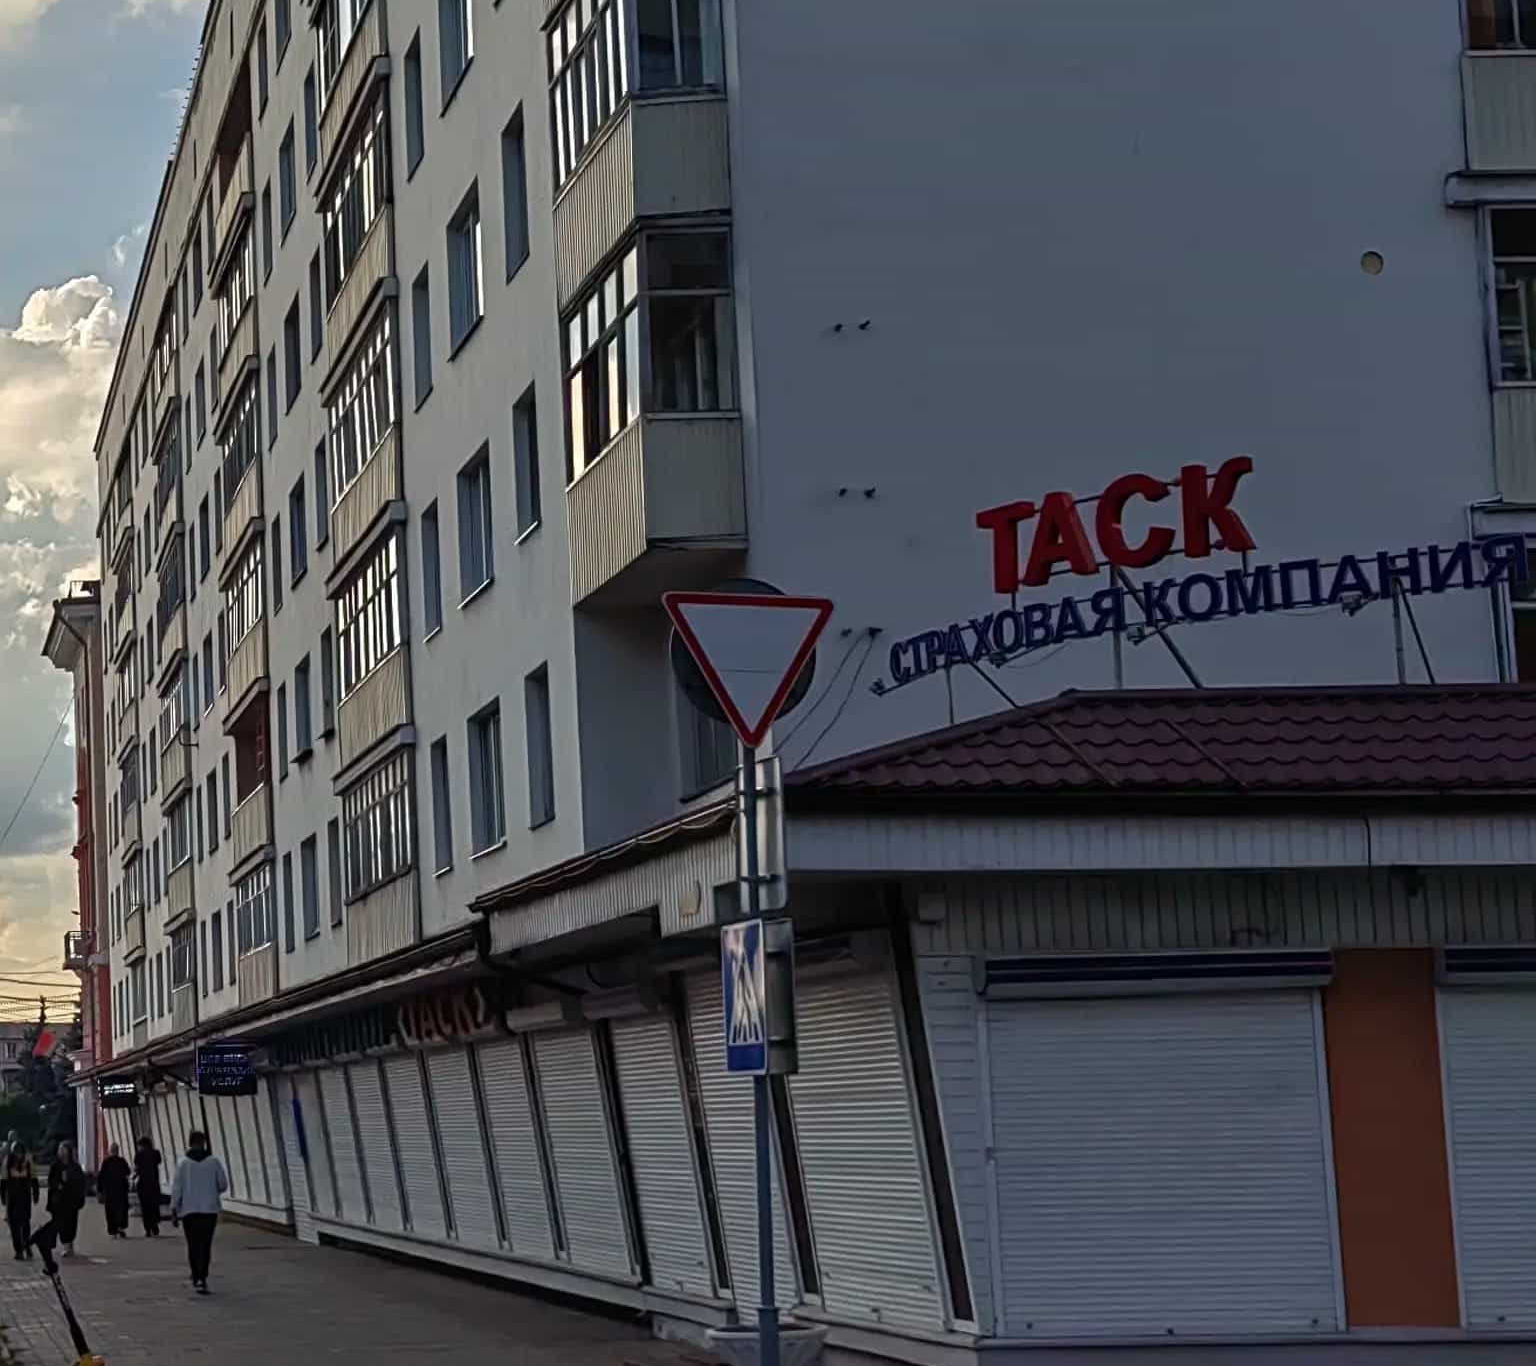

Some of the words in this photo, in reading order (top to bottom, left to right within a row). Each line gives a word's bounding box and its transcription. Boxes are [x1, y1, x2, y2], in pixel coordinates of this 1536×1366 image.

[976, 456, 1256, 593] ТАСК
[890, 587, 1125, 683] СТРАХОВАЯ
[1144, 533, 1528, 626] КОМПАНИЯ
